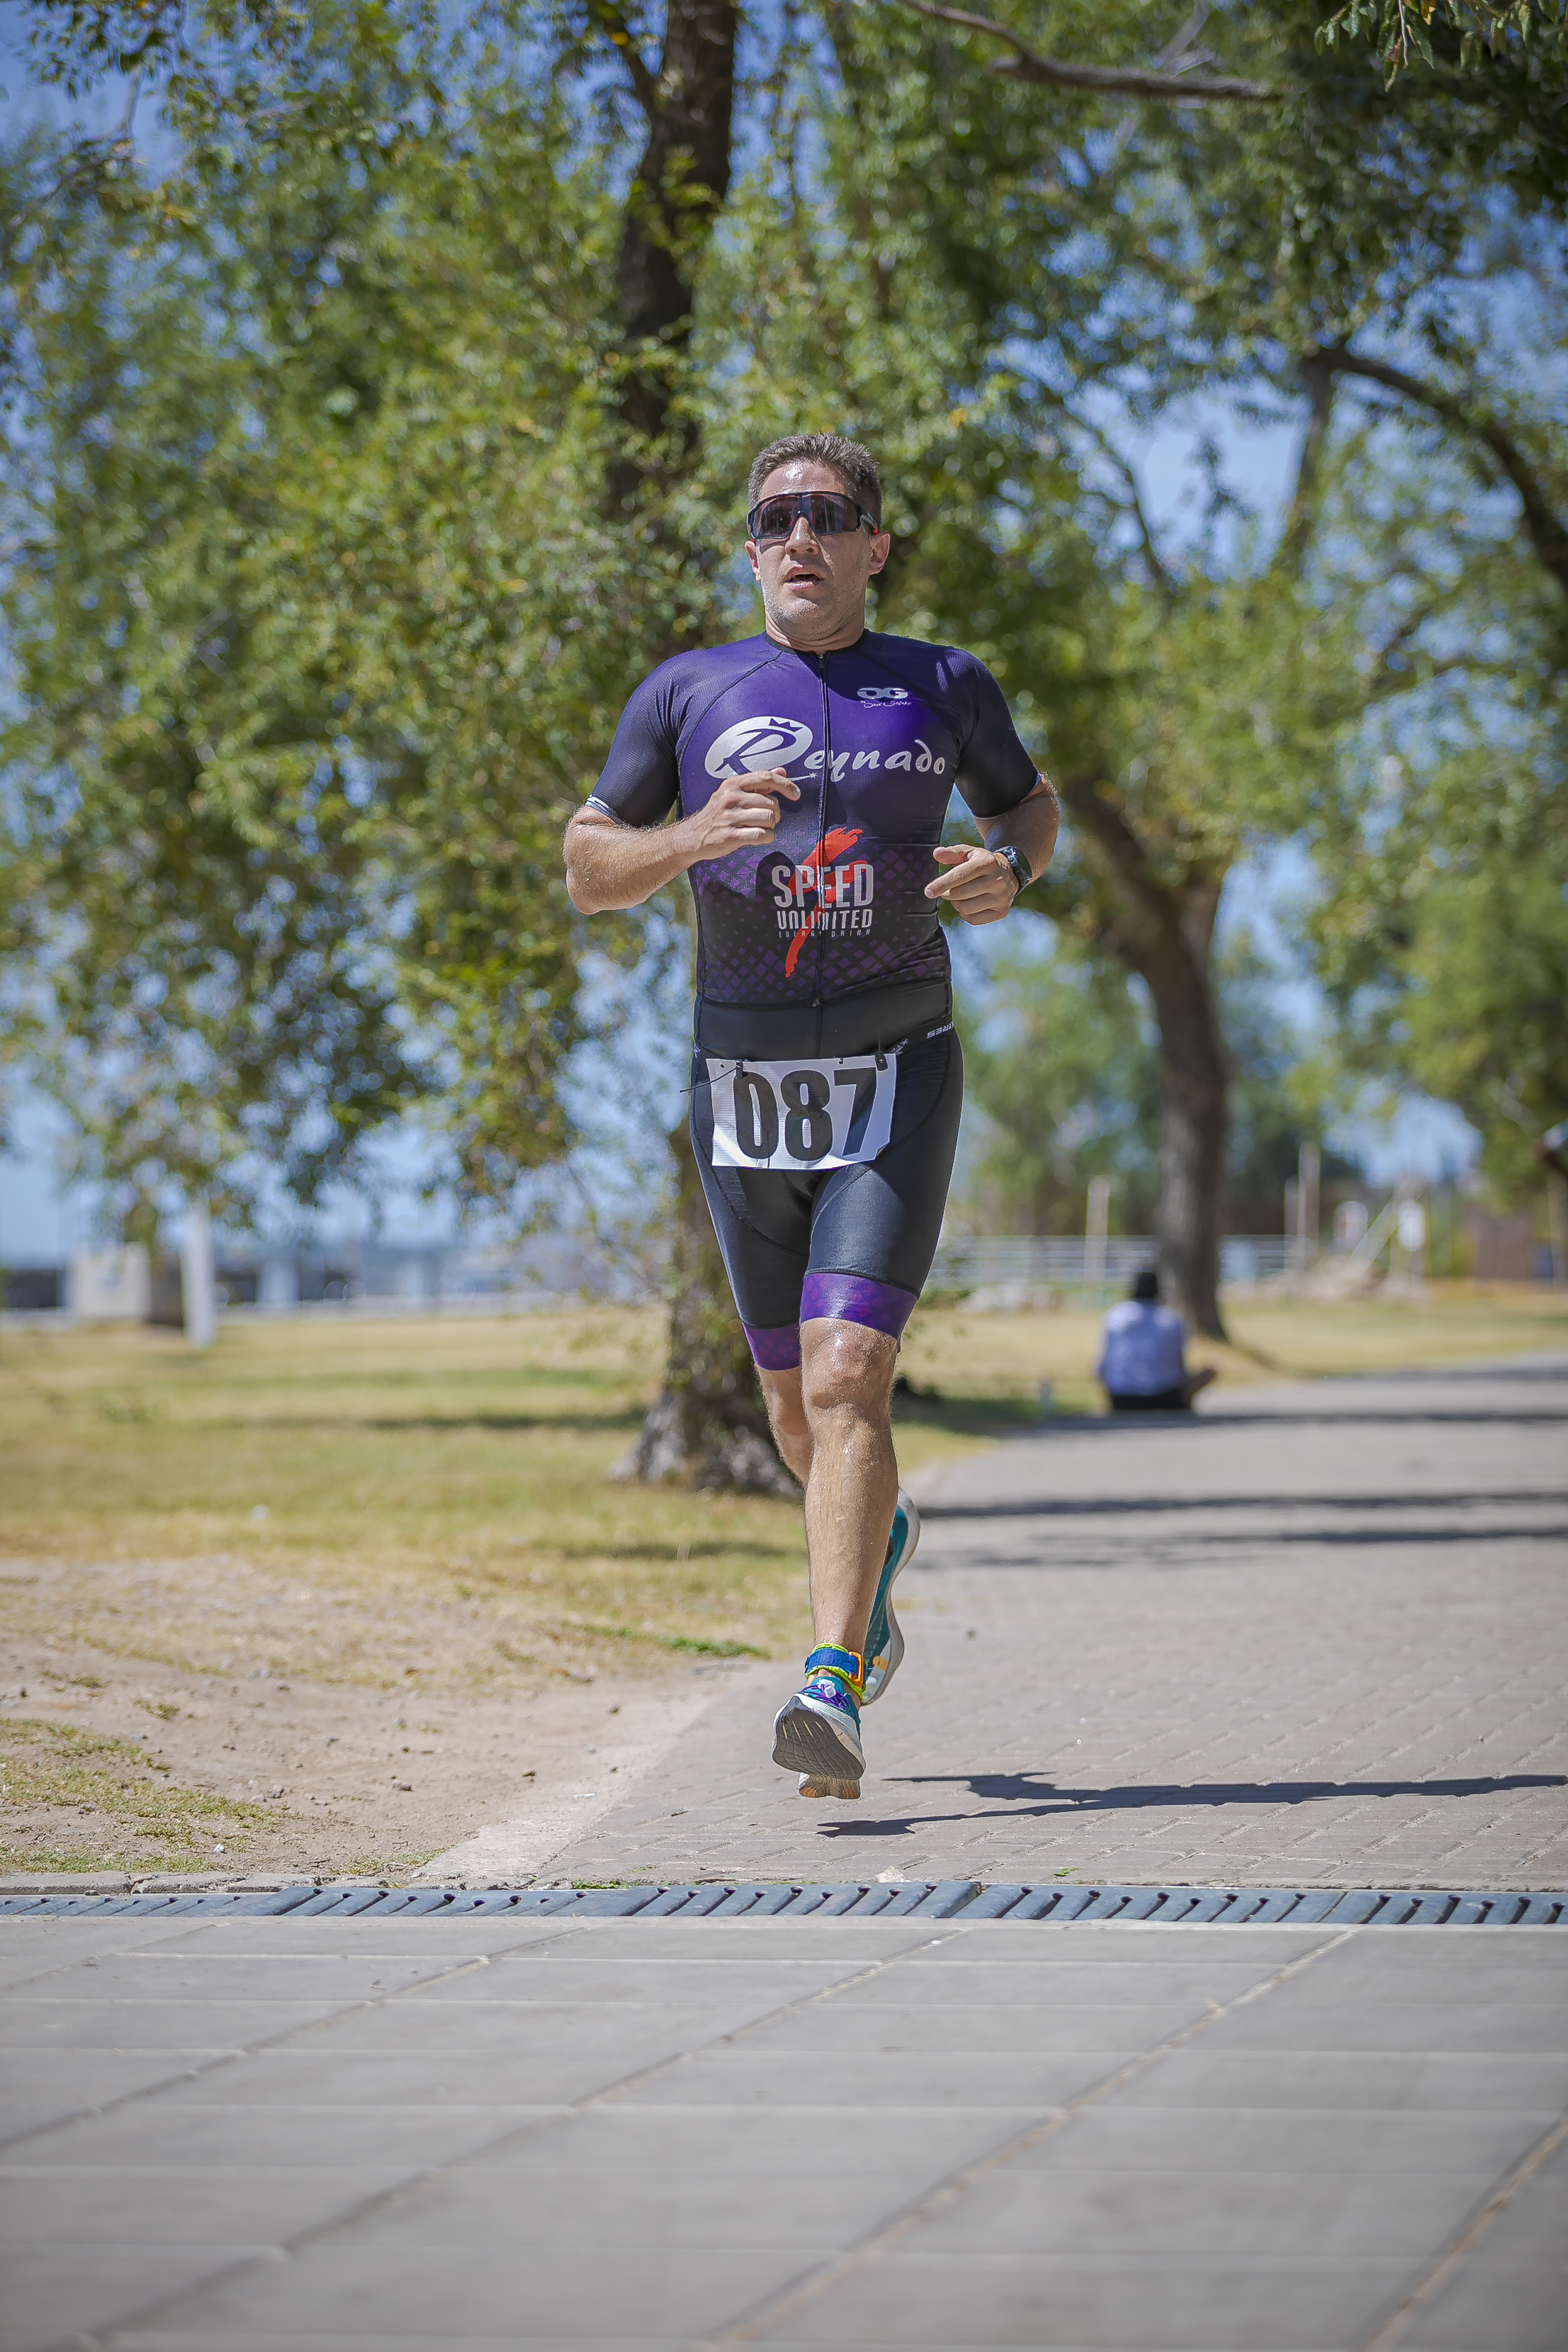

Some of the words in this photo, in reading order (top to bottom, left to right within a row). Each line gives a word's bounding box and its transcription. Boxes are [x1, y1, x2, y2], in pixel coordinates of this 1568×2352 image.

[705, 716, 945, 782] Reynado
[772, 864, 874, 908] SPEED
[777, 908, 873, 931] UNLIMITED
[733, 1067, 877, 1161] 087
